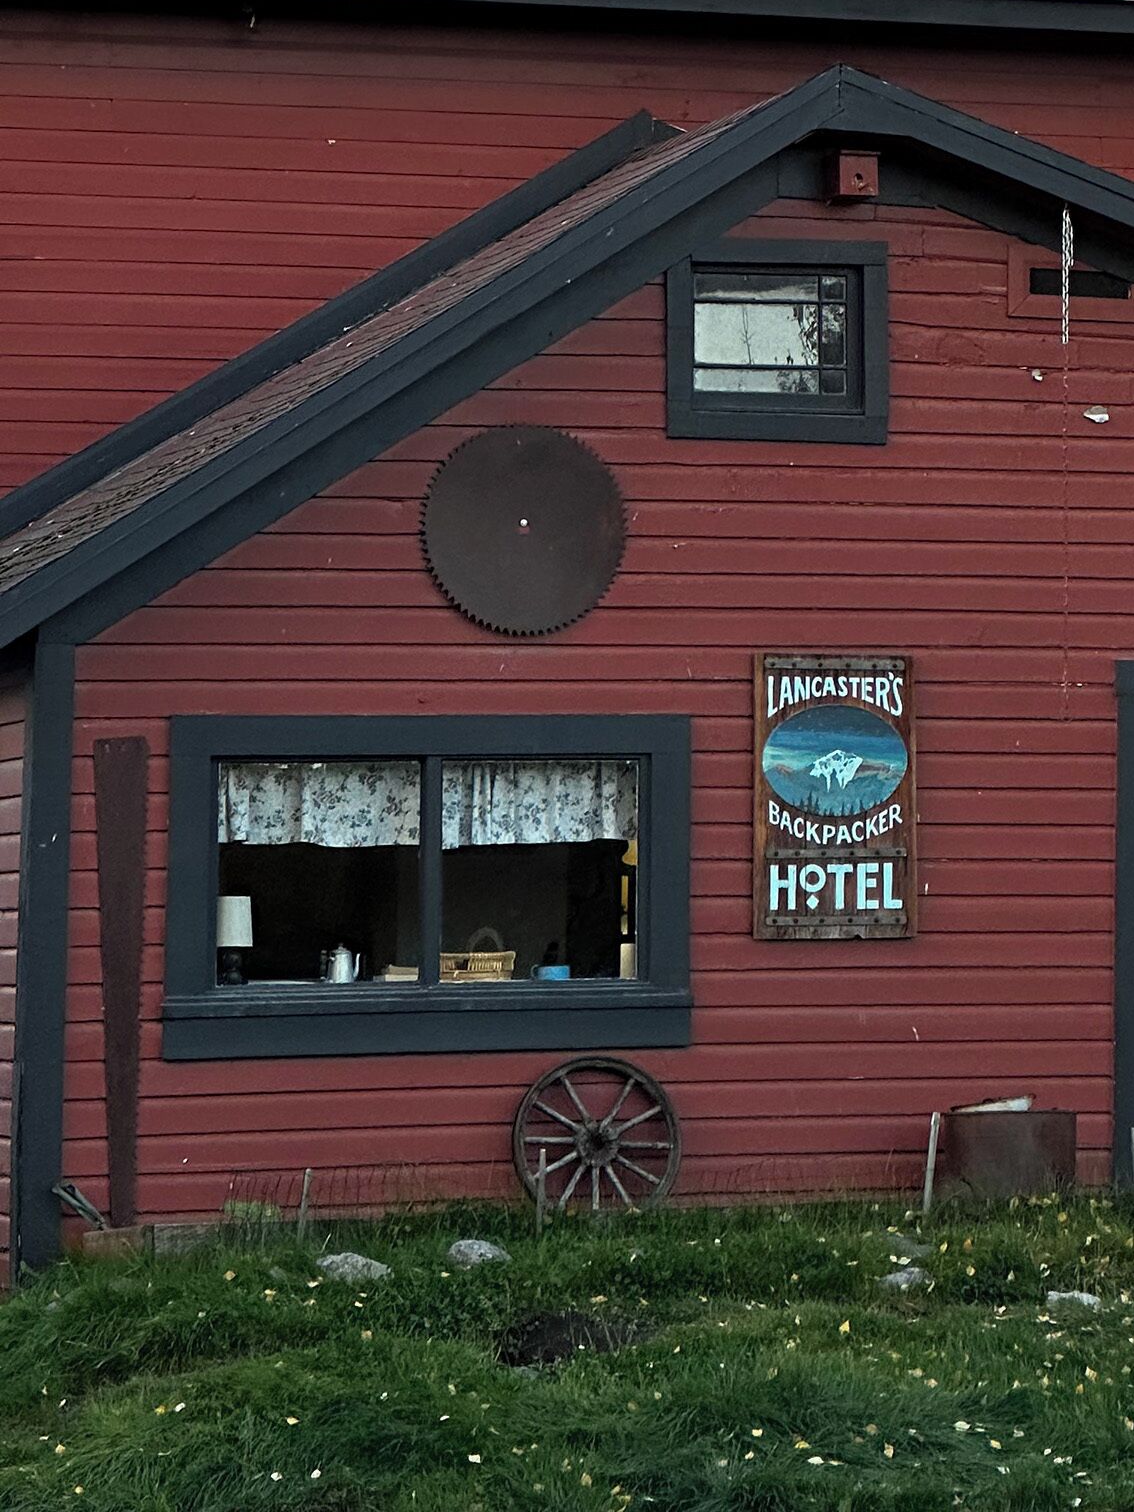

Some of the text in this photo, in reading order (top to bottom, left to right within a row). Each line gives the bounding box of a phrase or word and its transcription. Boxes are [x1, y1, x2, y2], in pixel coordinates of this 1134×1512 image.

[767, 672, 904, 719] LANCASTER'S
[768, 799, 903, 846] BACKPACKER
[769, 862, 903, 911] HOTEL
